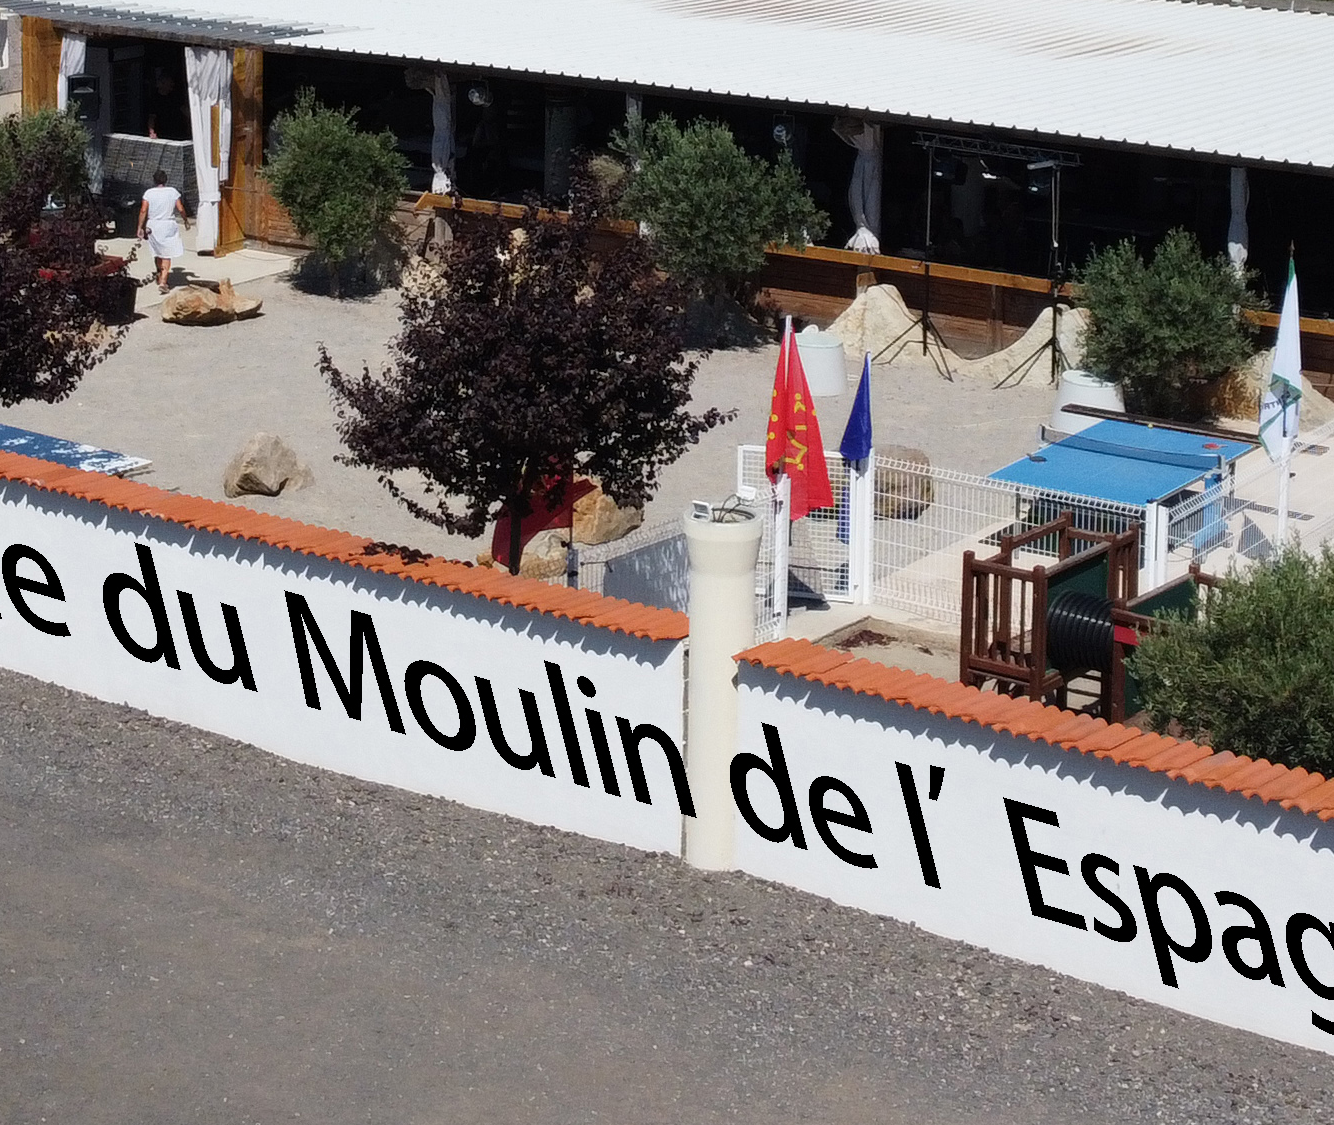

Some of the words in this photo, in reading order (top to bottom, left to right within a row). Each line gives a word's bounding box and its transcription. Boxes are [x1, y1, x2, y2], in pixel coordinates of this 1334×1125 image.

[103, 542, 259, 693] du
[284, 590, 698, 819] Moulin
[730, 722, 879, 870] de
